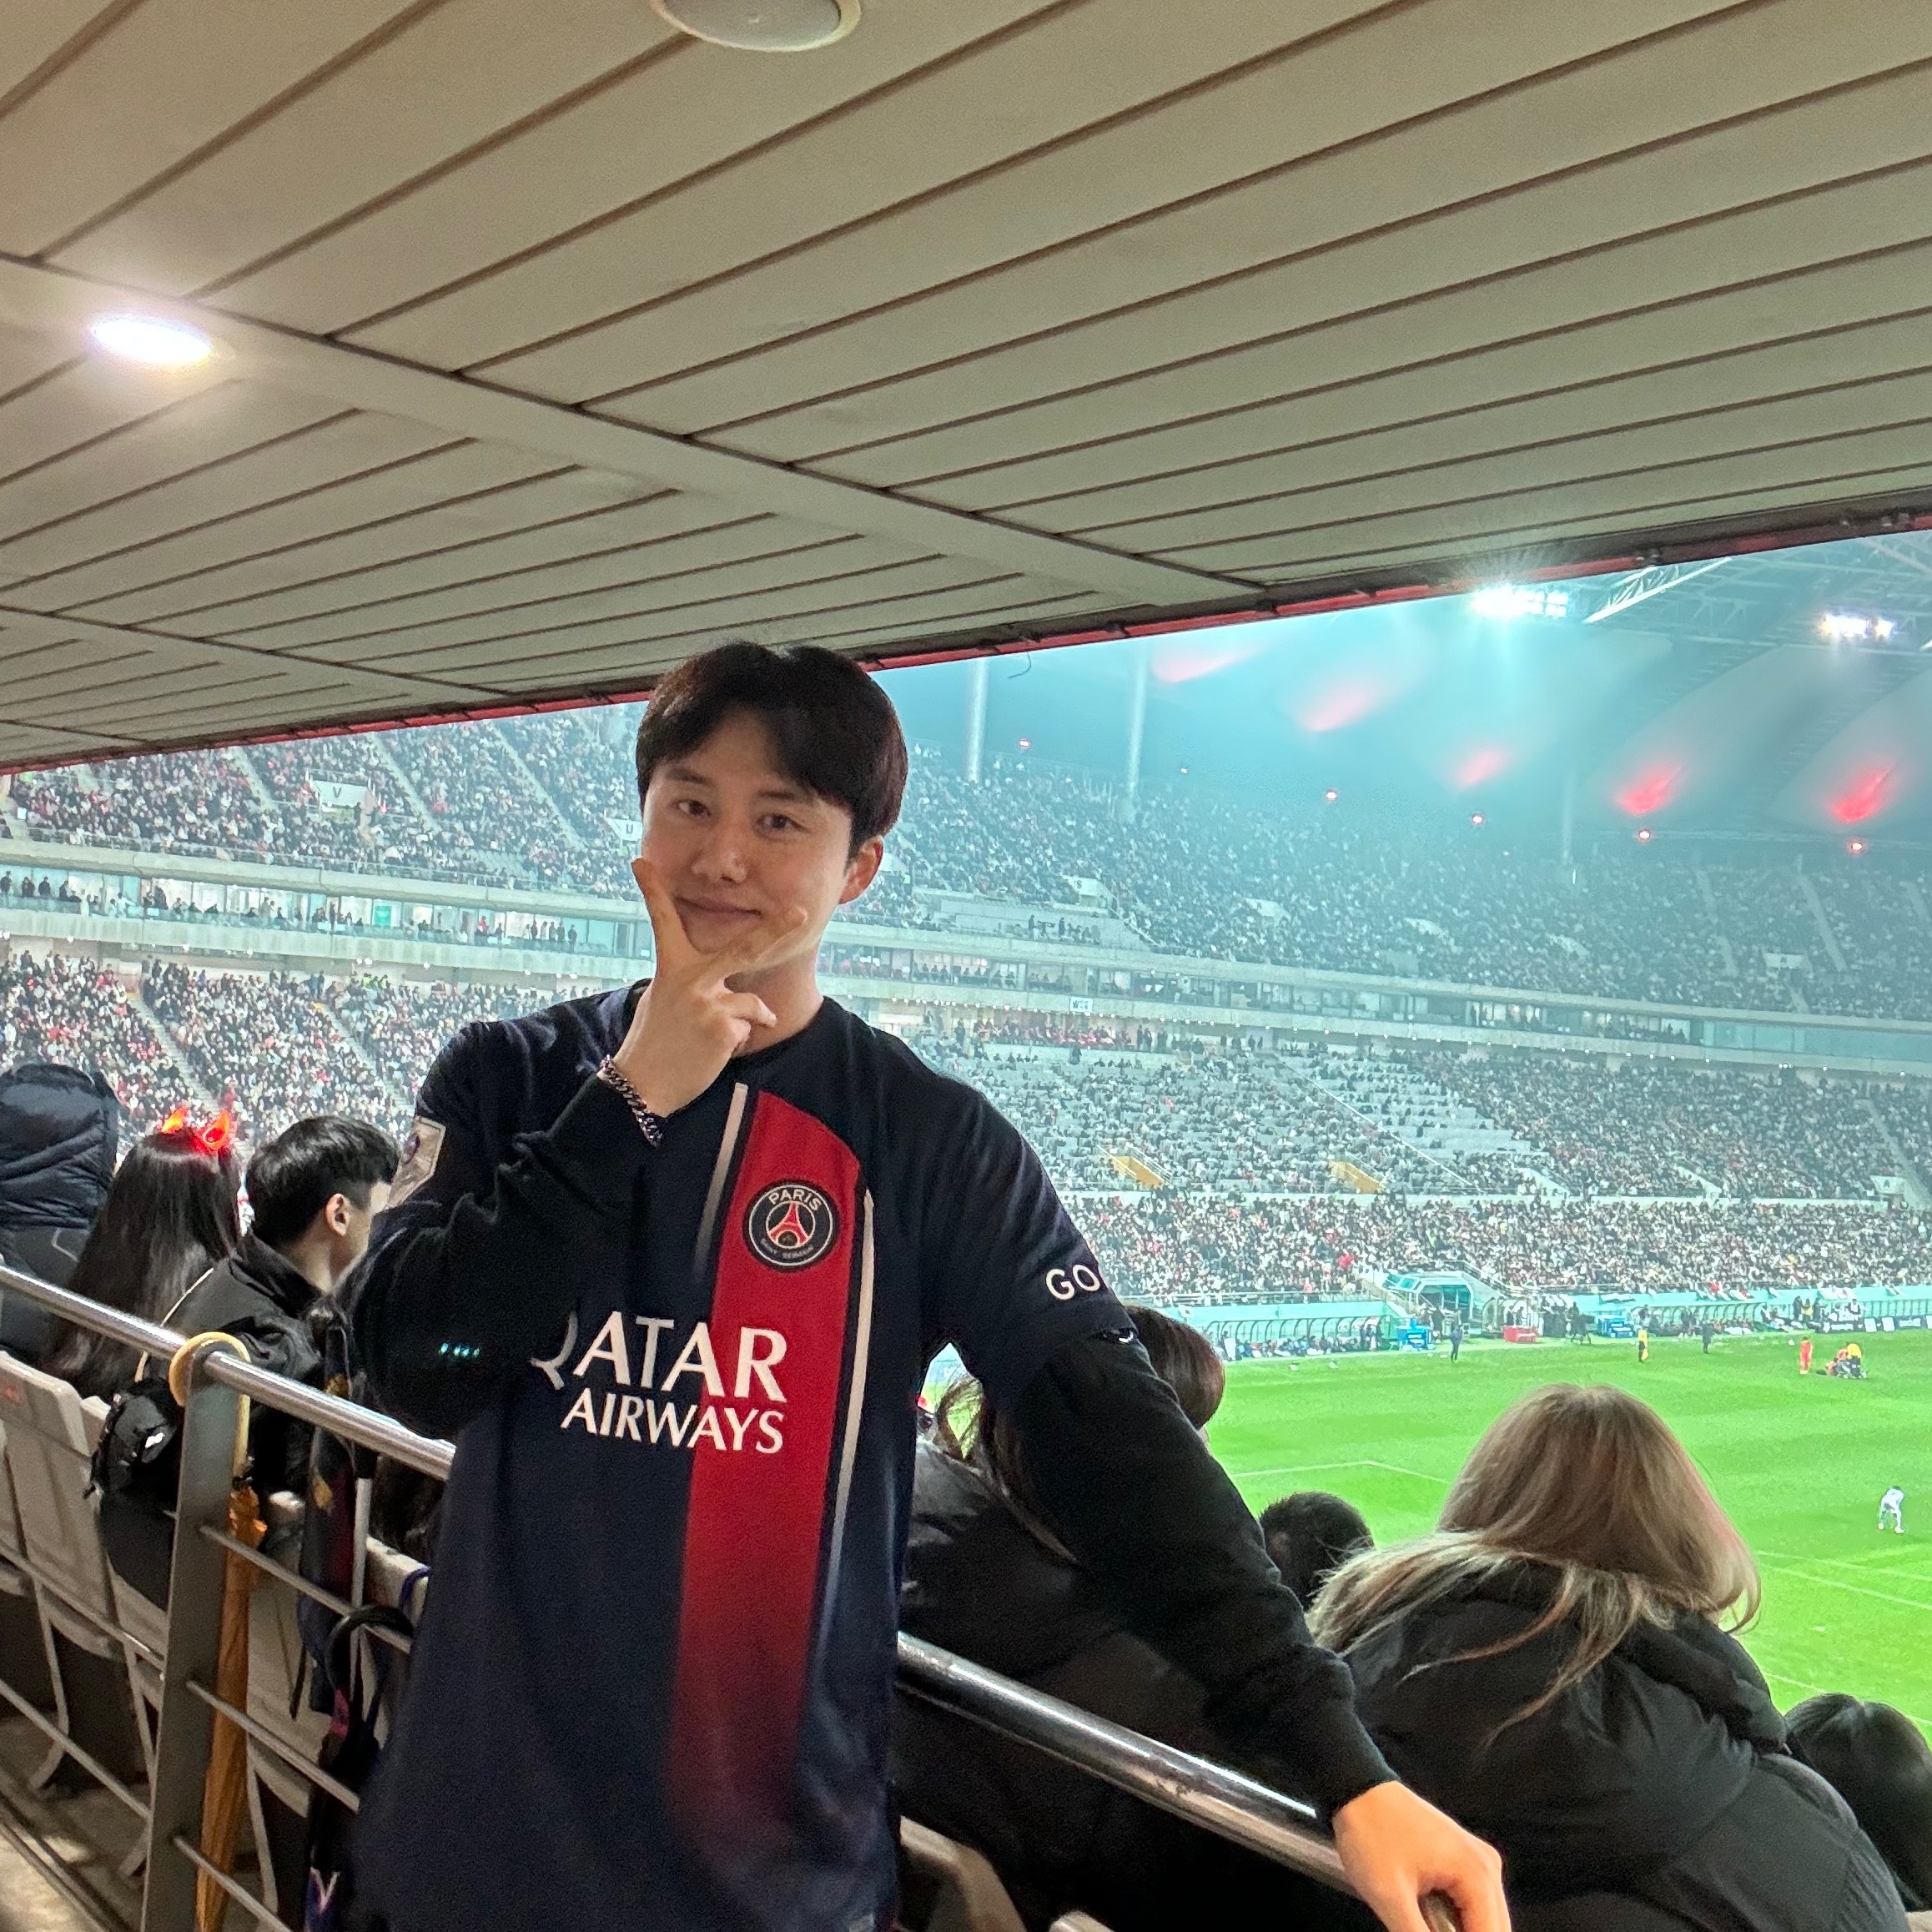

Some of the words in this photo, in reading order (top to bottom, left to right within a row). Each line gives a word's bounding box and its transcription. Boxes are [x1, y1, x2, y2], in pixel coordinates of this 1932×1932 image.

[333, 787, 342, 798] V
[626, 823, 634, 833] U
[768, 1189, 822, 1211] PARIS
[1045, 1264, 1101, 1301] GO
[560, 1388, 784, 1454] AIRWAYS
